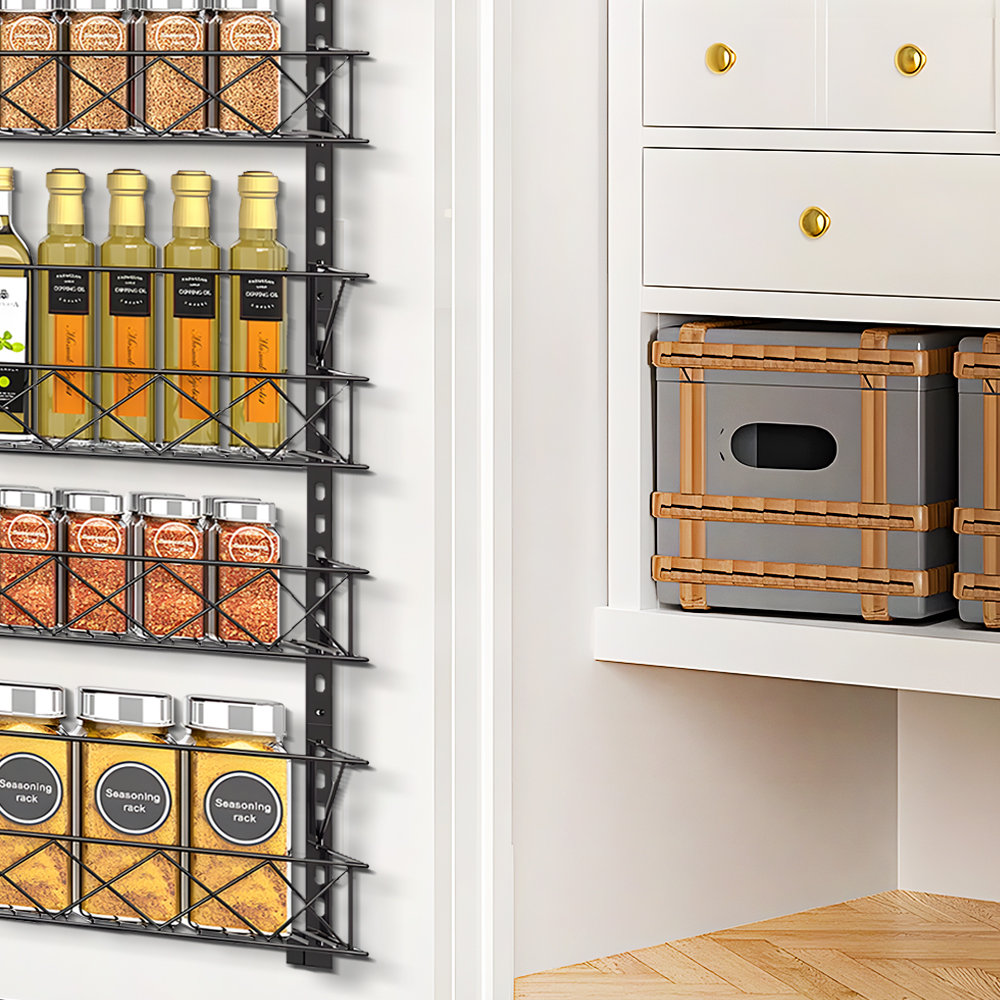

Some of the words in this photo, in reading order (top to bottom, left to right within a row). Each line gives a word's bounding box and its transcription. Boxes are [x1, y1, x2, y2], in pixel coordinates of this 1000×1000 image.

[0, 779, 53, 794] Seasoning
[15, 793, 38, 804] rack
[105, 788, 161, 804] Seasoning
[123, 804, 146, 814] rack
[215, 798, 272, 814] Seasoning
[233, 814, 257, 824] rack
